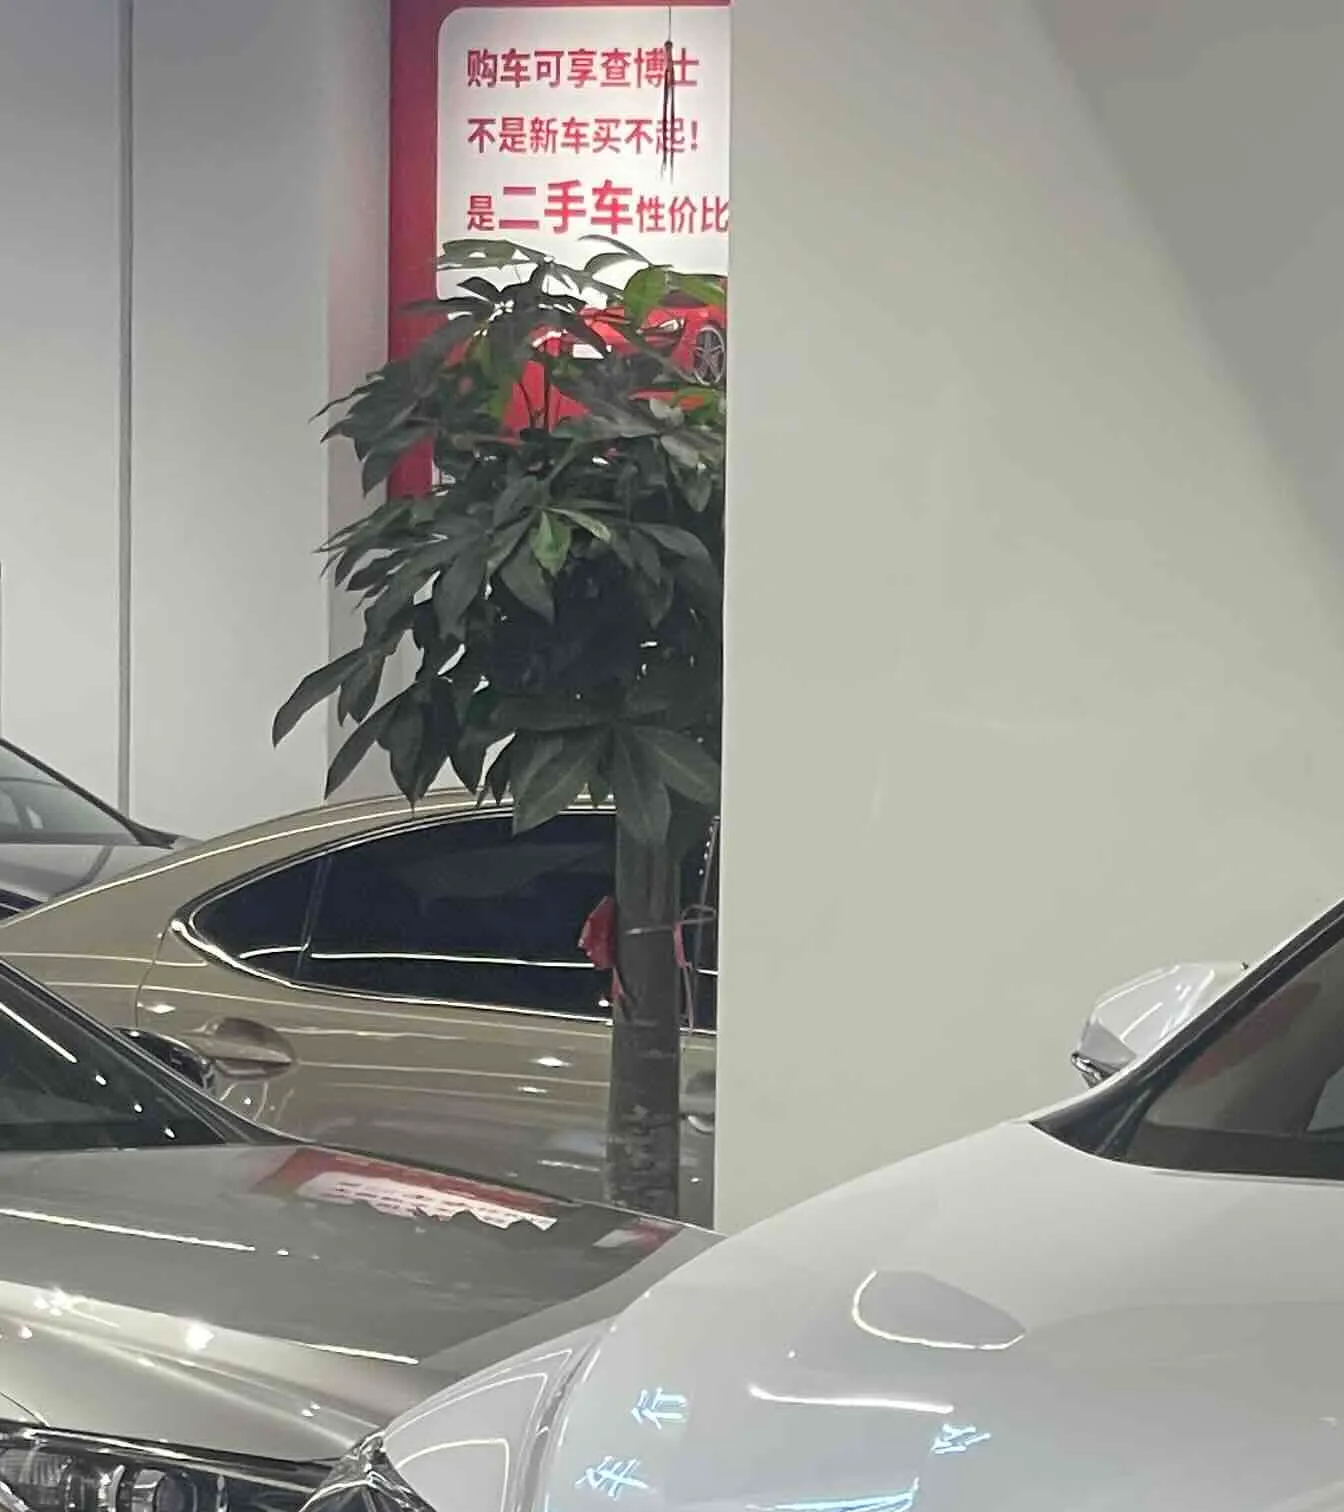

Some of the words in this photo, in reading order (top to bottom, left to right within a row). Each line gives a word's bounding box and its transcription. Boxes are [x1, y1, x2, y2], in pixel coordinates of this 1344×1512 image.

[467, 179, 729, 235] 是二手车性价比
